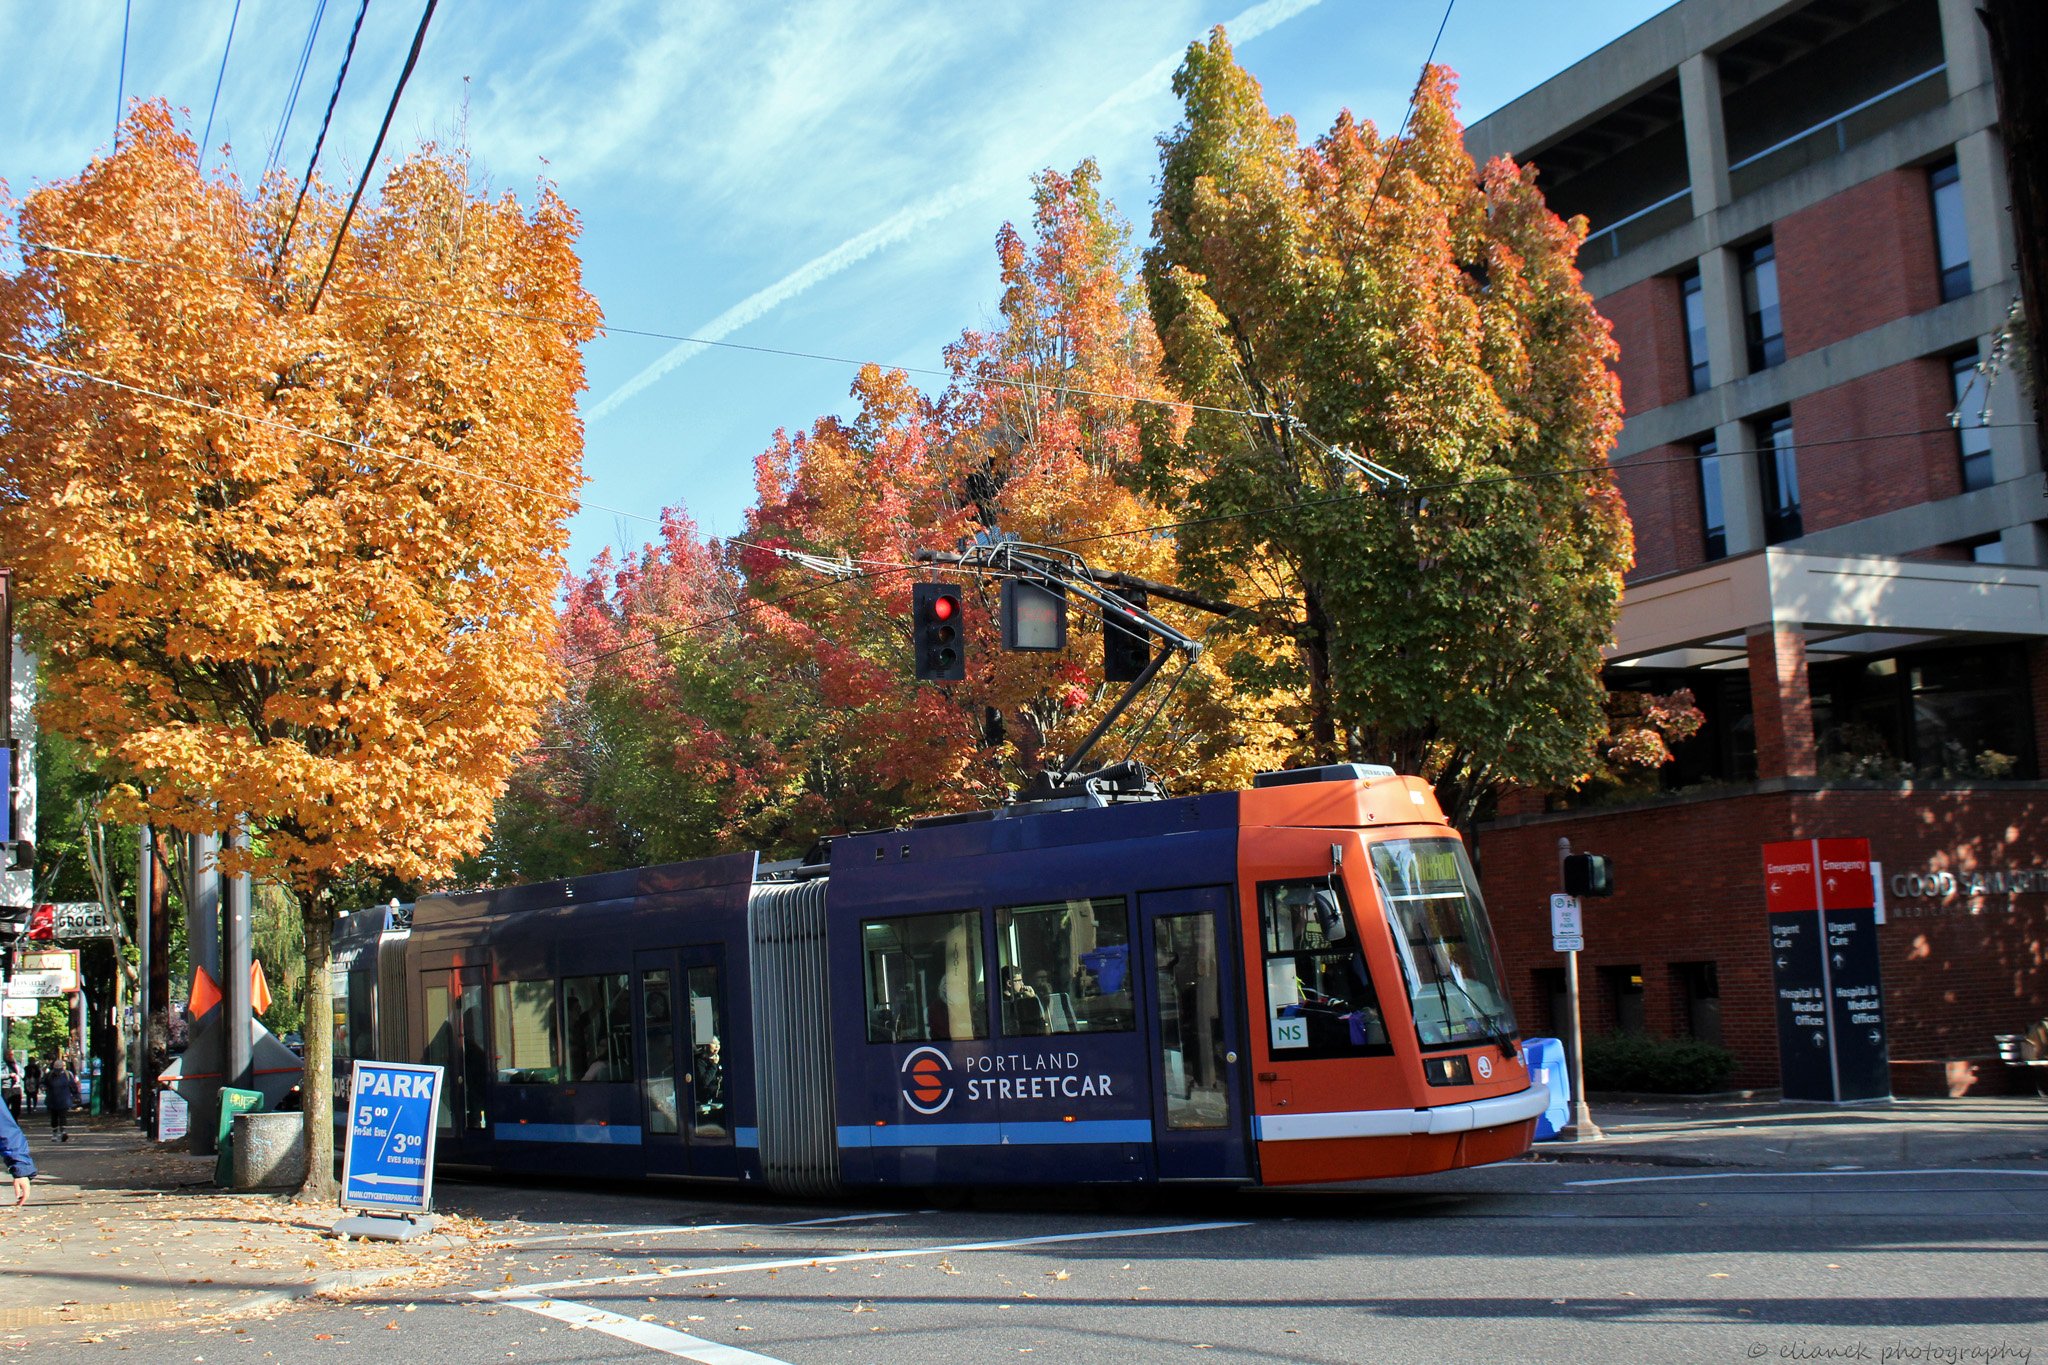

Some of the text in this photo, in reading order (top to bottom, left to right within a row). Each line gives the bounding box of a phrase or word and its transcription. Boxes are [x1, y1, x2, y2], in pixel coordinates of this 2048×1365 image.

[1767, 863, 1810, 875] Emergency
[1822, 860, 1866, 872] Emergency
[1891, 871, 1957, 898] GOOD
[1772, 925, 1800, 937] Urgent
[1828, 922, 1856, 935] Urgent
[1773, 938, 1793, 948] Care
[1829, 936, 1849, 946] Care
[1780, 987, 1822, 1000] Hospital &
[1836, 985, 1878, 999] Hospital &
[1792, 1001, 1824, 1012] Medical
[1847, 999, 1879, 1011] Medical
[1795, 1014, 1824, 1026] Offices
[1851, 1012, 1880, 1025] Offices
[1278, 1025, 1301, 1041] NS
[966, 1053, 1079, 1072] PORTLAND
[358, 1072, 434, 1099] PARK
[968, 1075, 1113, 1101] STREETCAR
[387, 1155, 401, 1164] EVES
